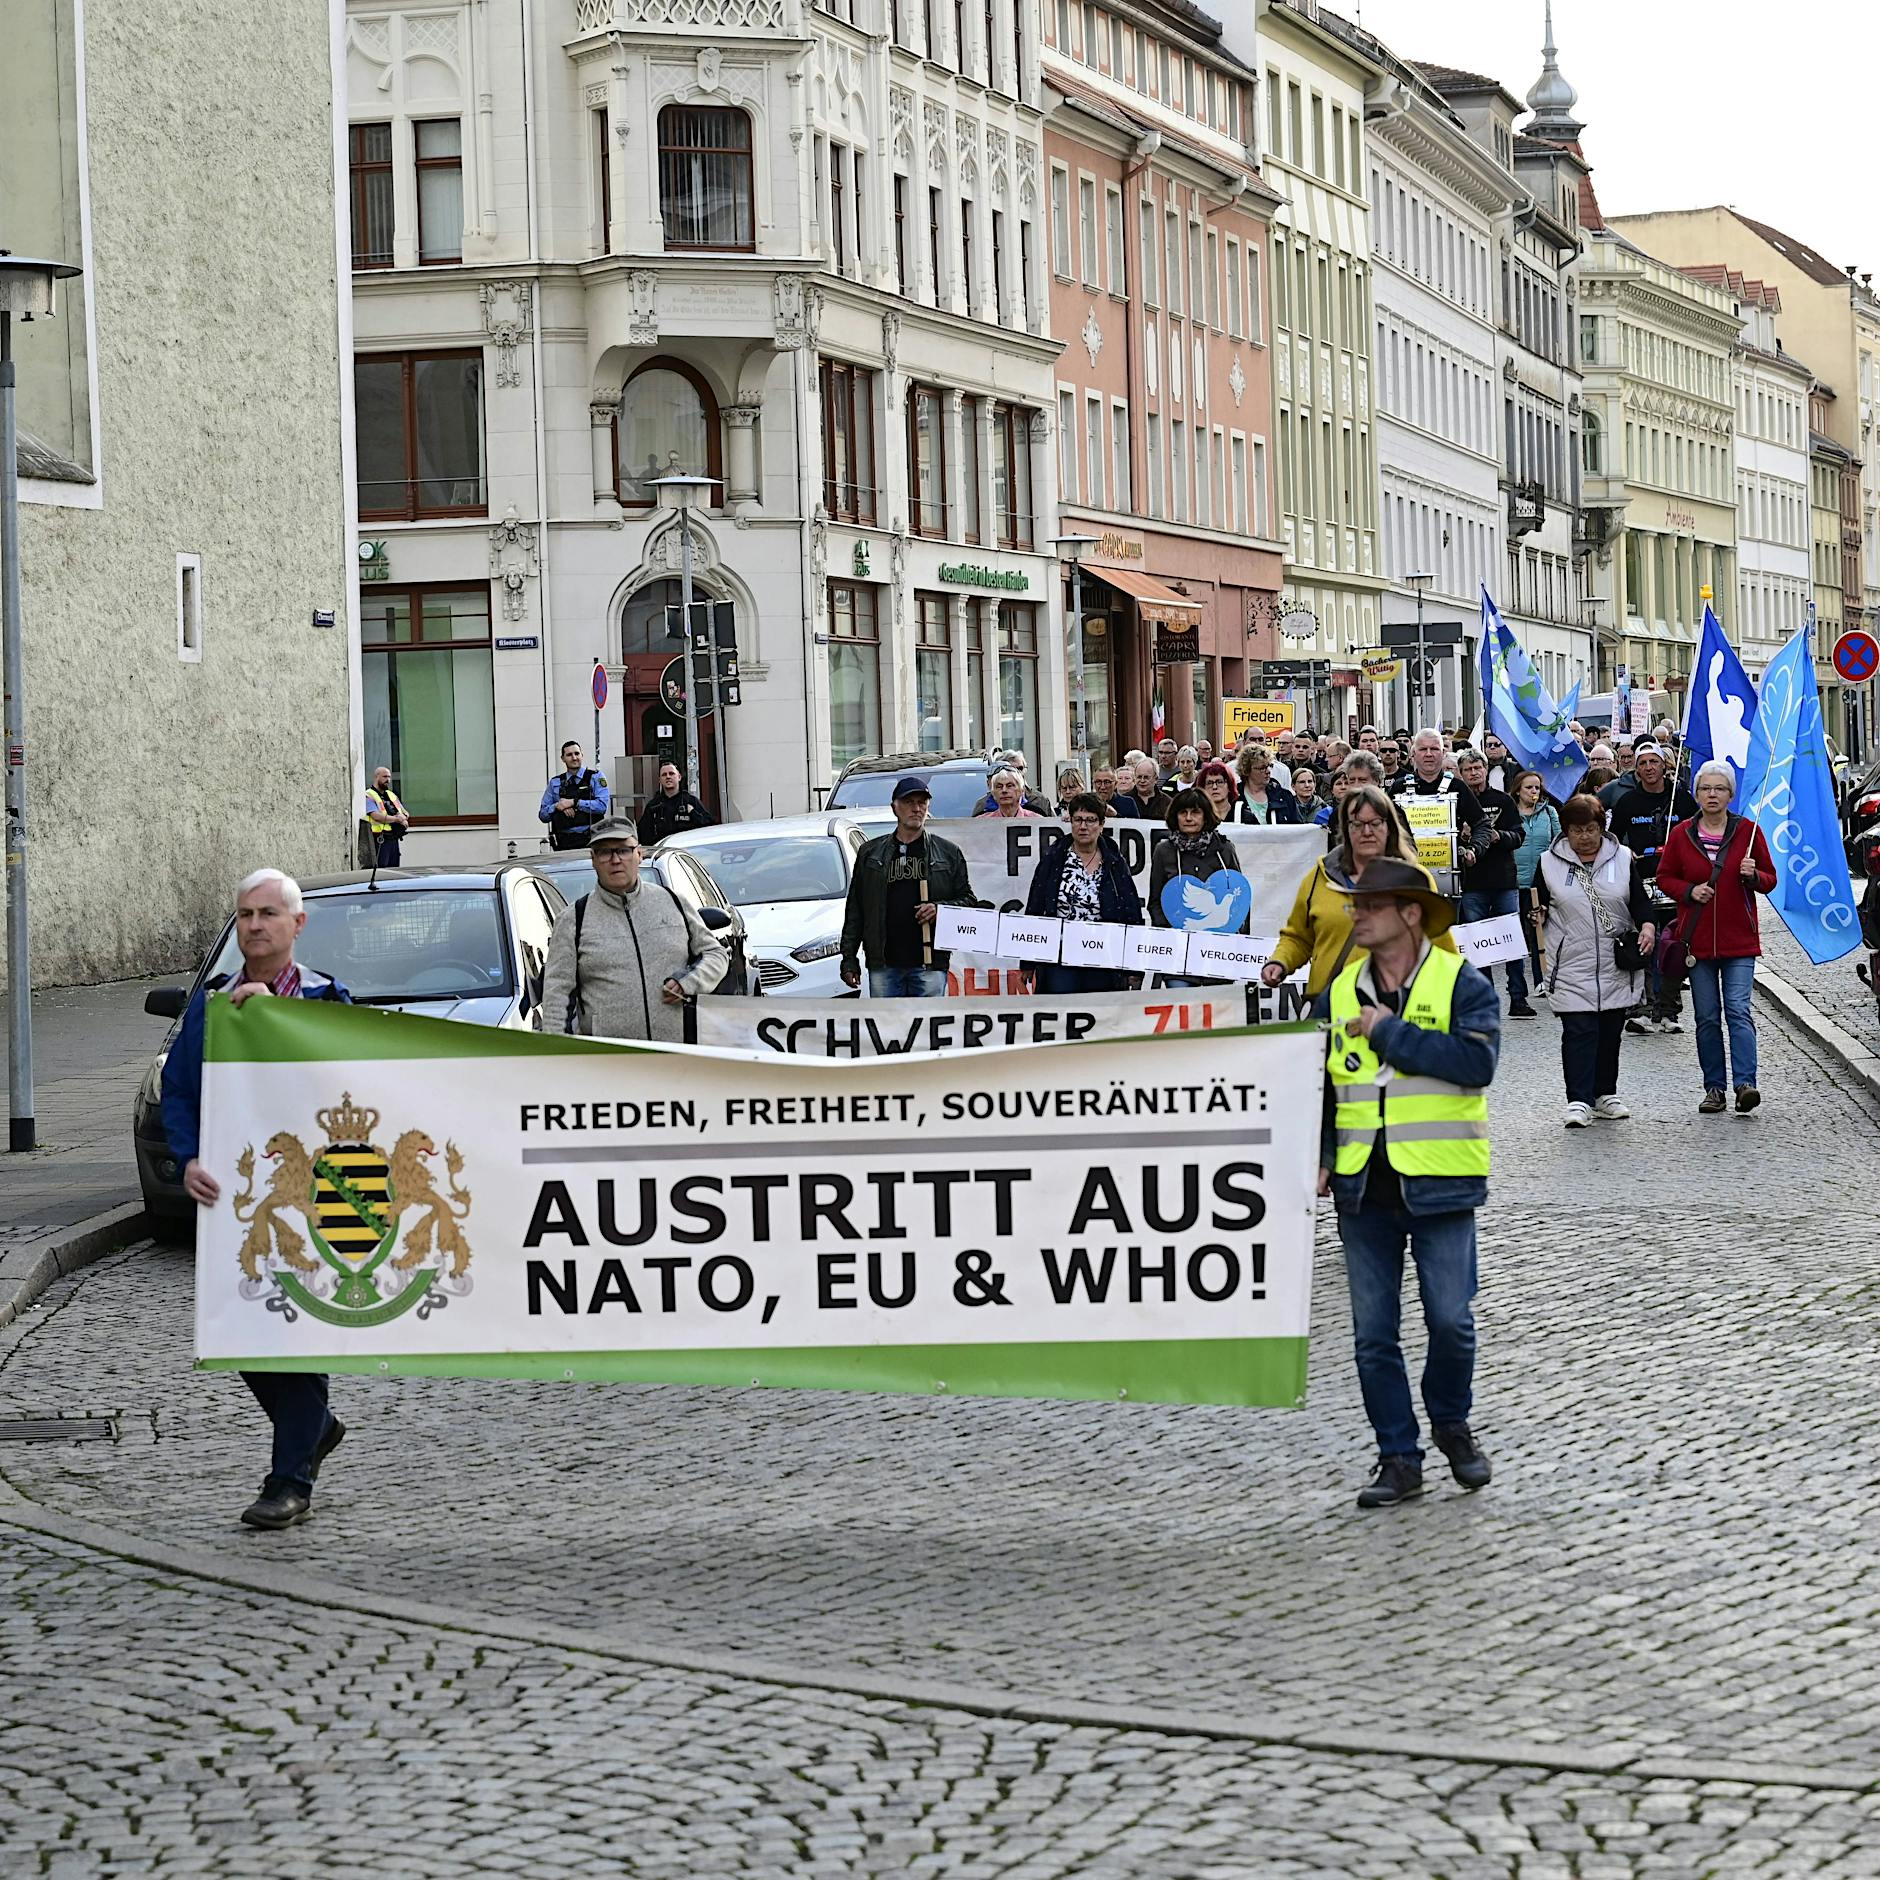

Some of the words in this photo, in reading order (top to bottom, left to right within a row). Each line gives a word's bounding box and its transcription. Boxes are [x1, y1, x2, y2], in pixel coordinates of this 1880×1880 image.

[359, 541, 388, 562] OK
[1233, 707, 1284, 723] Frieden
[957, 925, 977, 935] WIR
[1011, 933, 1048, 944] HABEN
[1081, 940, 1103, 950] VON
[1137, 944, 1173, 956] EURER
[1473, 936, 1501, 950] VOLL
[1502, 933, 1513, 943] !!!
[756, 1012, 1096, 1059] SCHWERTER
[520, 1100, 708, 1133] FRIEDEN,
[726, 1094, 926, 1127] FREIHEIT,
[942, 1077, 1267, 1120] SOUVERÄNITÄT:
[522, 1168, 1032, 1248] AUSTRITT
[1068, 1161, 1266, 1235] AUS
[526, 1255, 780, 1324] NATO,
[817, 1251, 917, 1309] EU
[953, 1249, 1014, 1307] &
[1040, 1243, 1267, 1304] WHO!
